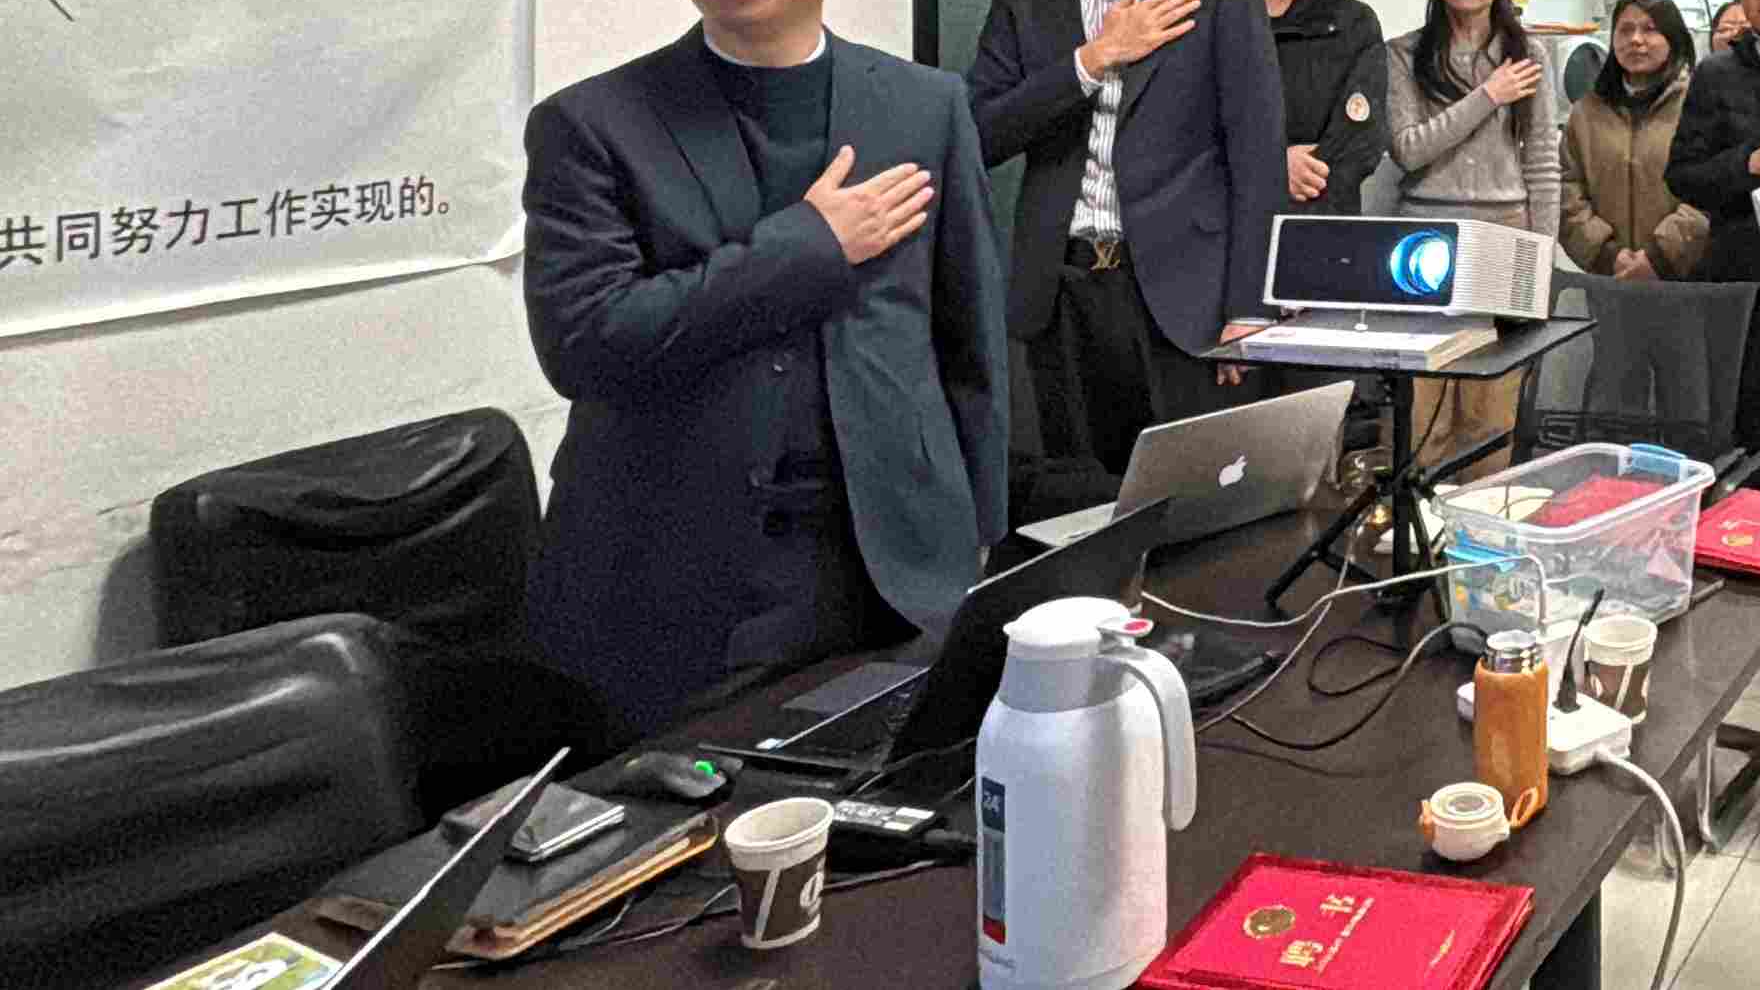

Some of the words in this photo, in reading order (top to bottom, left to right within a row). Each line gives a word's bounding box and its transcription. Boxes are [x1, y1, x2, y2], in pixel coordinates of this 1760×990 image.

[0, 176, 450, 267] 共同努力工作实现的。
